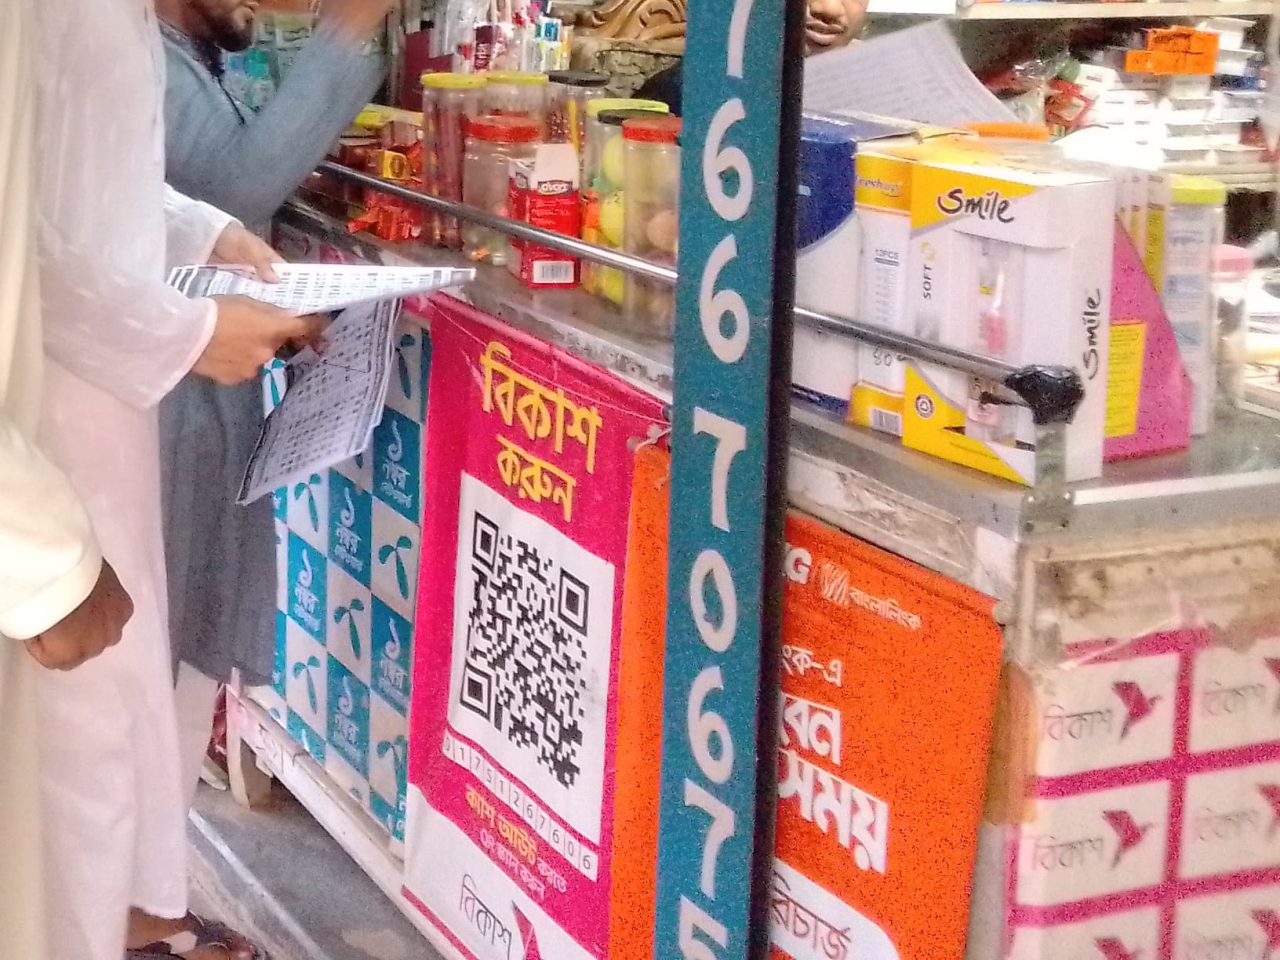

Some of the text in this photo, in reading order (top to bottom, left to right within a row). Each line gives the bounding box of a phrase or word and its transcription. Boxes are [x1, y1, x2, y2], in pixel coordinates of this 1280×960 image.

[937, 188, 1015, 224] Smile
[923, 265, 933, 300] SOFT
[1082, 288, 1101, 381] Smile
[480, 341, 602, 474] বিকাশ
[497, 434, 576, 522] করুন
[782, 547, 812, 585] G
[850, 585, 921, 630] বাংলালিংক
[460, 873, 512, 960] বিকাশ
